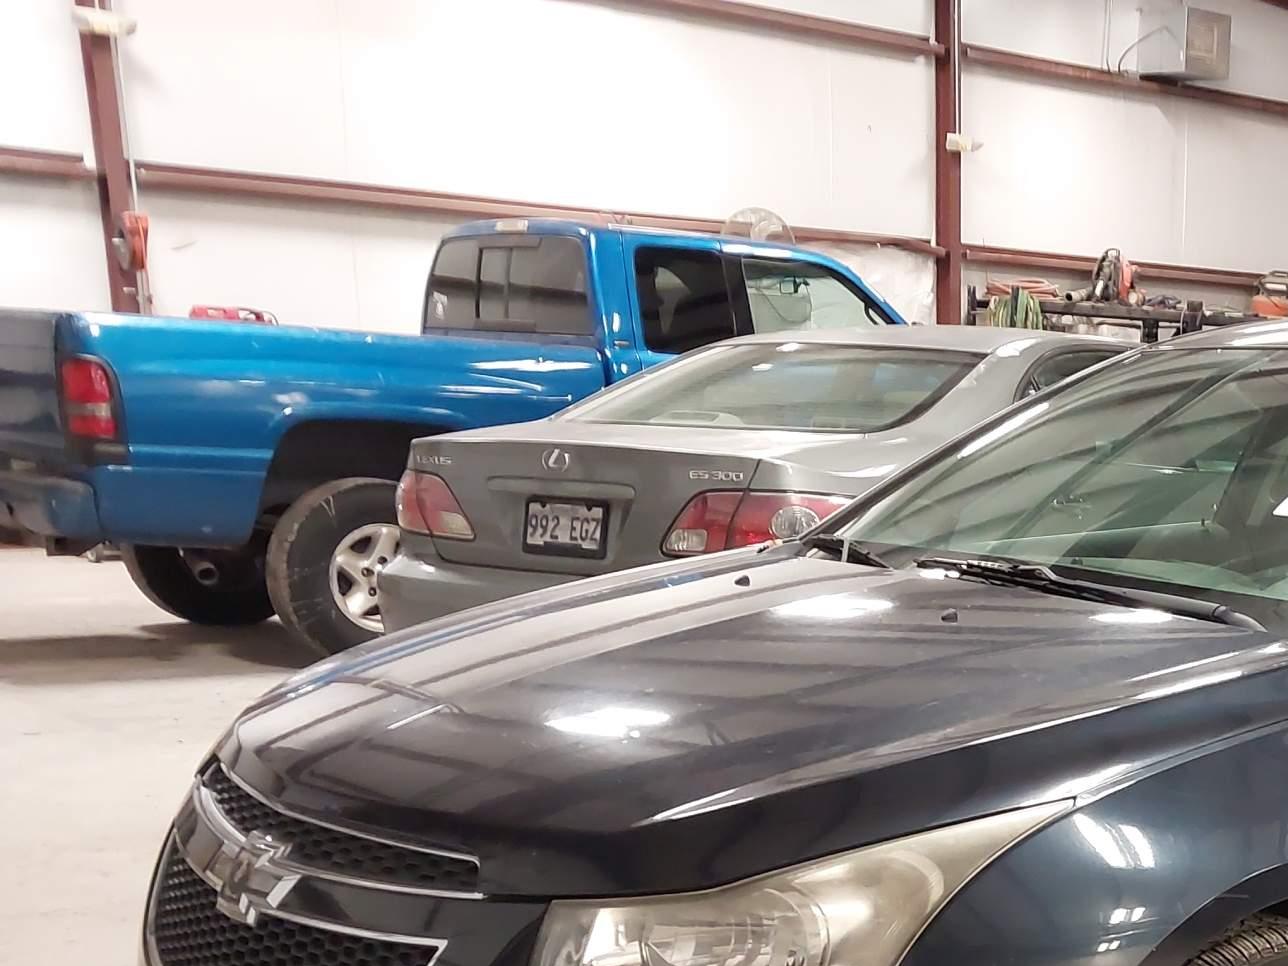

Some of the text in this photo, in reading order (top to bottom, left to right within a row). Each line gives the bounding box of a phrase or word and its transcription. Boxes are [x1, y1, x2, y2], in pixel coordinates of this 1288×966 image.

[689, 470, 744, 482] ES 300
[529, 513, 600, 542] 992 EGZ
